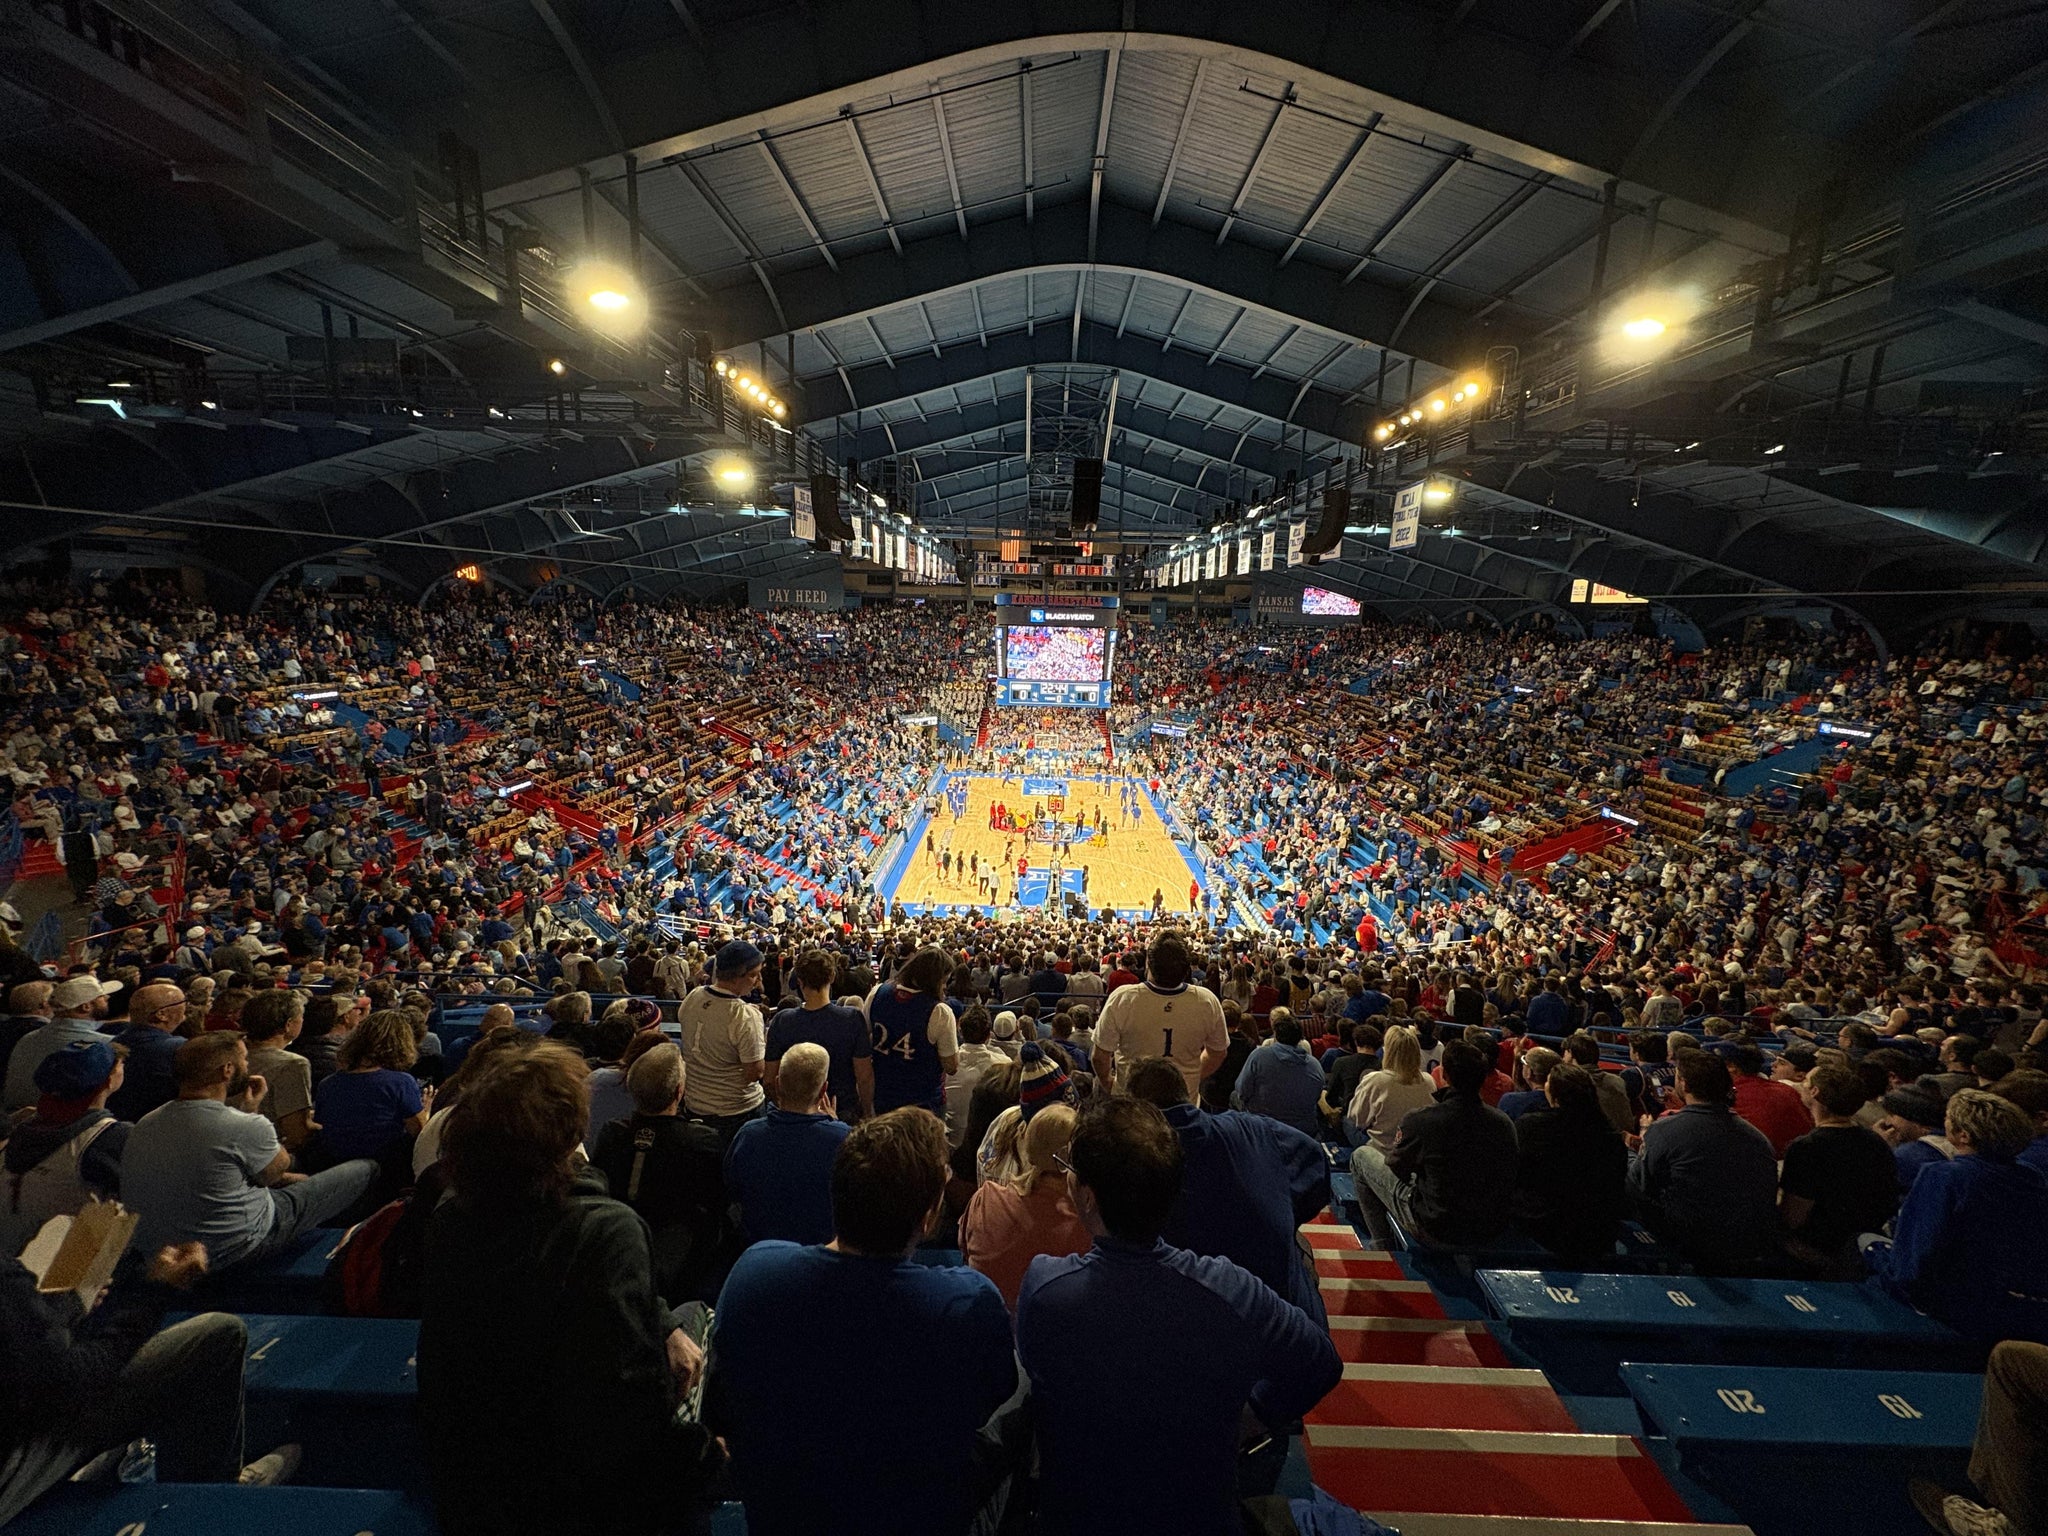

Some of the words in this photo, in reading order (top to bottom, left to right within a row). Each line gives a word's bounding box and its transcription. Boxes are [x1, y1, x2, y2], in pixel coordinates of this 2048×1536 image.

[768, 588, 790, 603] PAY
[795, 589, 827, 604] HEED
[1011, 594, 1046, 605] KANSAS
[1048, 594, 1103, 607] BASKETBALL
[1258, 595, 1294, 606] KANSAS
[873, 1021, 916, 1060] 24
[1162, 1027, 1173, 1058] 1
[1546, 1286, 1580, 1304] 20
[1666, 1290, 1697, 1307] 19
[1716, 1388, 1766, 1414] 20
[1877, 1394, 1924, 1419] 19
